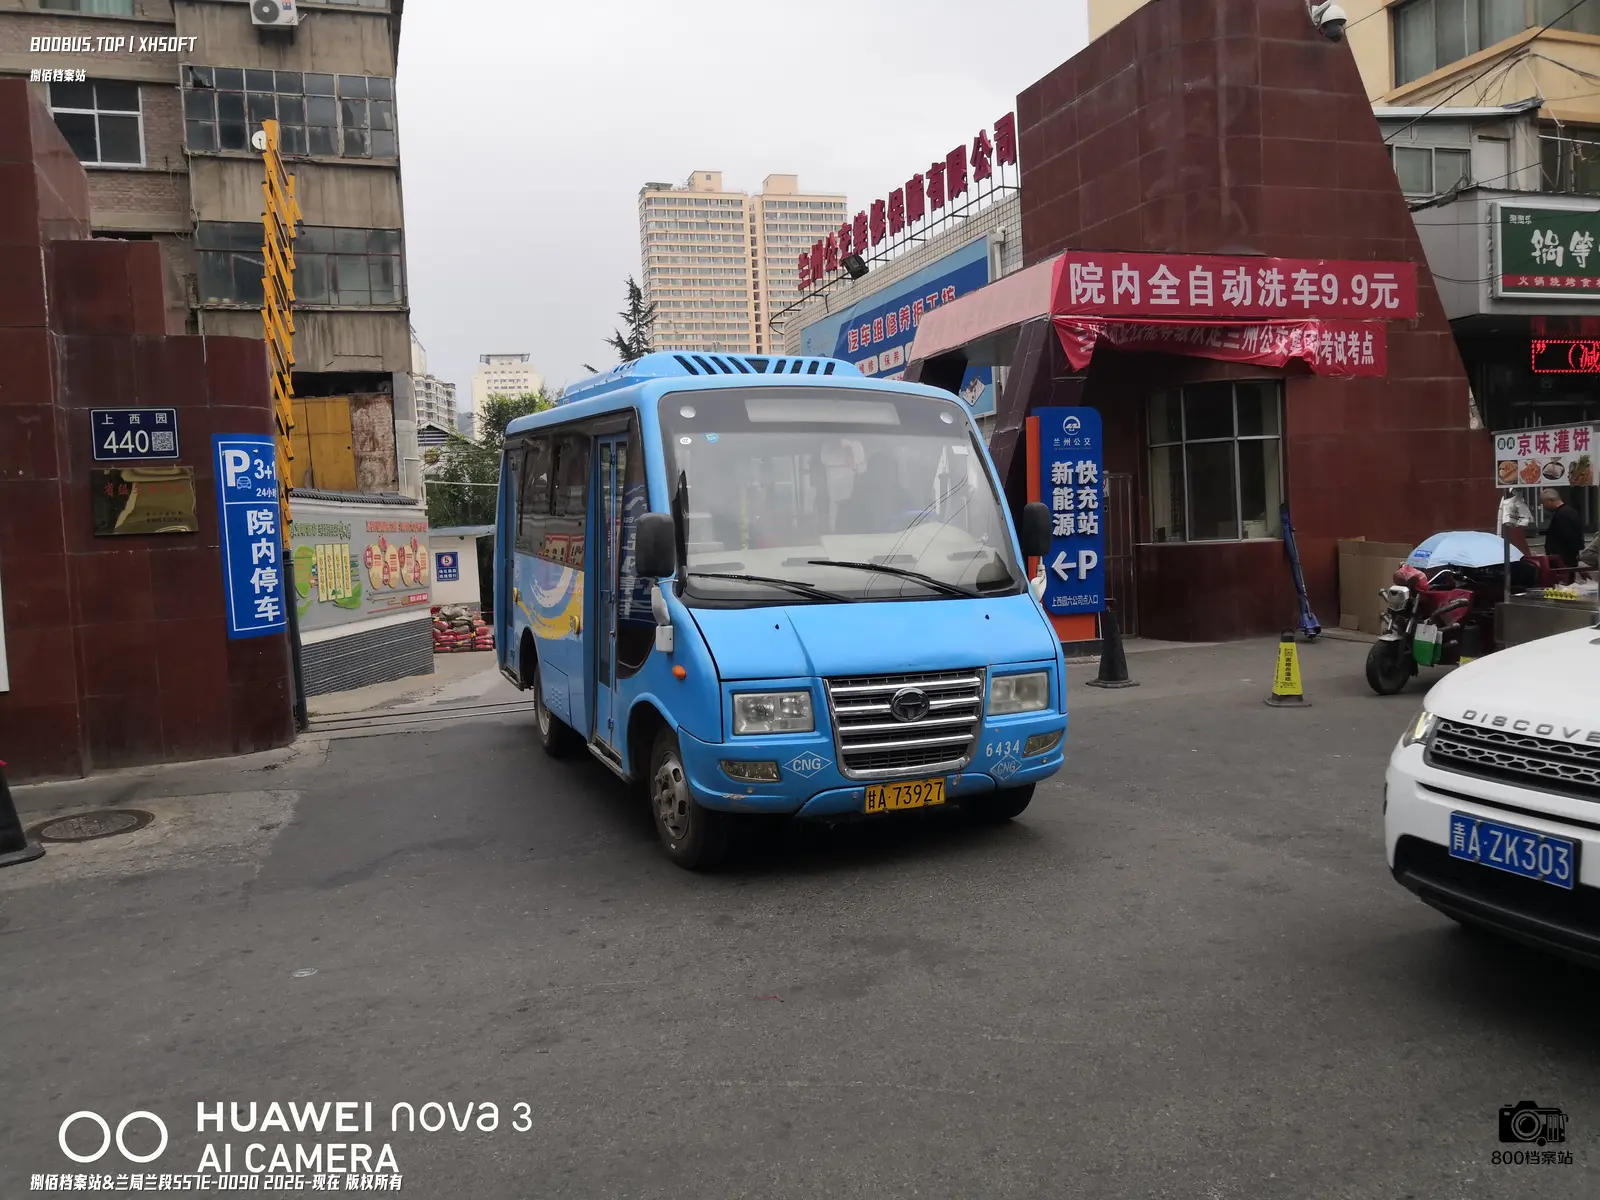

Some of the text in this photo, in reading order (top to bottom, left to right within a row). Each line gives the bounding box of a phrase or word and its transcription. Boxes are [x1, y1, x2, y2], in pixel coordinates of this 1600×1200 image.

[1069, 262, 1400, 309] 院内全自动洗车9.9元
[101, 412, 168, 425] 上西园
[103, 430, 149, 453] 440
[1053, 437, 1092, 447] 兰州公交
[1517, 427, 1590, 457] 京味灌饼
[225, 450, 250, 487] P
[246, 509, 280, 622] 院内停车
[1078, 550, 1098, 580] P
[986, 740, 1020, 757] 6434
[792, 758, 821, 772] CNG
